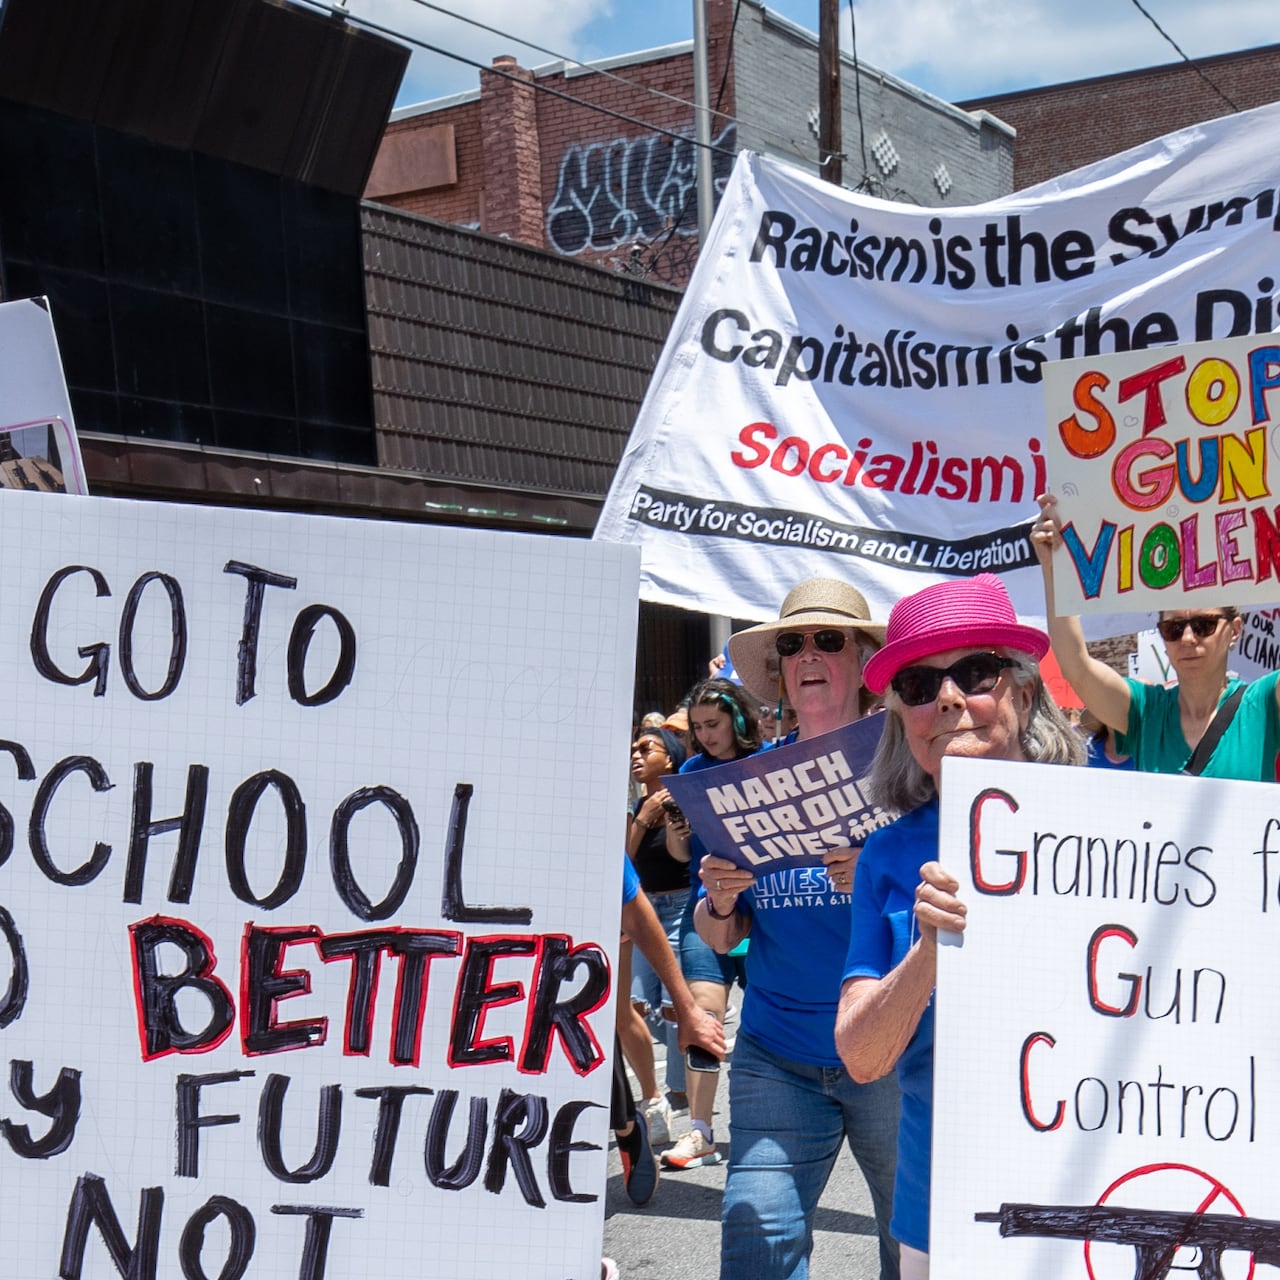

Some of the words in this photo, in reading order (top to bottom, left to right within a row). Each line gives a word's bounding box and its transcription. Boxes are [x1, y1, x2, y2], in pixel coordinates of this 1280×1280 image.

[749, 210, 928, 285] Racism
[932, 217, 976, 290] is
[980, 215, 1096, 288] the
[700, 308, 995, 389] Capitalism
[1054, 304, 1179, 357] the
[730, 421, 1025, 503] Socialism
[1029, 437, 1046, 502] i
[1111, 426, 1273, 512] GUN
[631, 492, 694, 533] Party
[699, 502, 737, 533] for
[736, 512, 859, 553] Socialism
[862, 537, 916, 565] and
[916, 535, 1031, 570] Liberation
[29, 564, 189, 703] GO
[1252, 614, 1276, 638] OUR
[706, 750, 853, 815] MARCH
[722, 804, 807, 843] FOR
[739, 824, 851, 866] LIVES
[969, 787, 1218, 908] Grannies
[752, 866, 828, 898] LIVES
[756, 895, 824, 910] ATLANTA
[127, 913, 613, 1079] BETTER
[1086, 923, 1227, 1025] Gun
[173, 1068, 609, 1210] FUTURE
